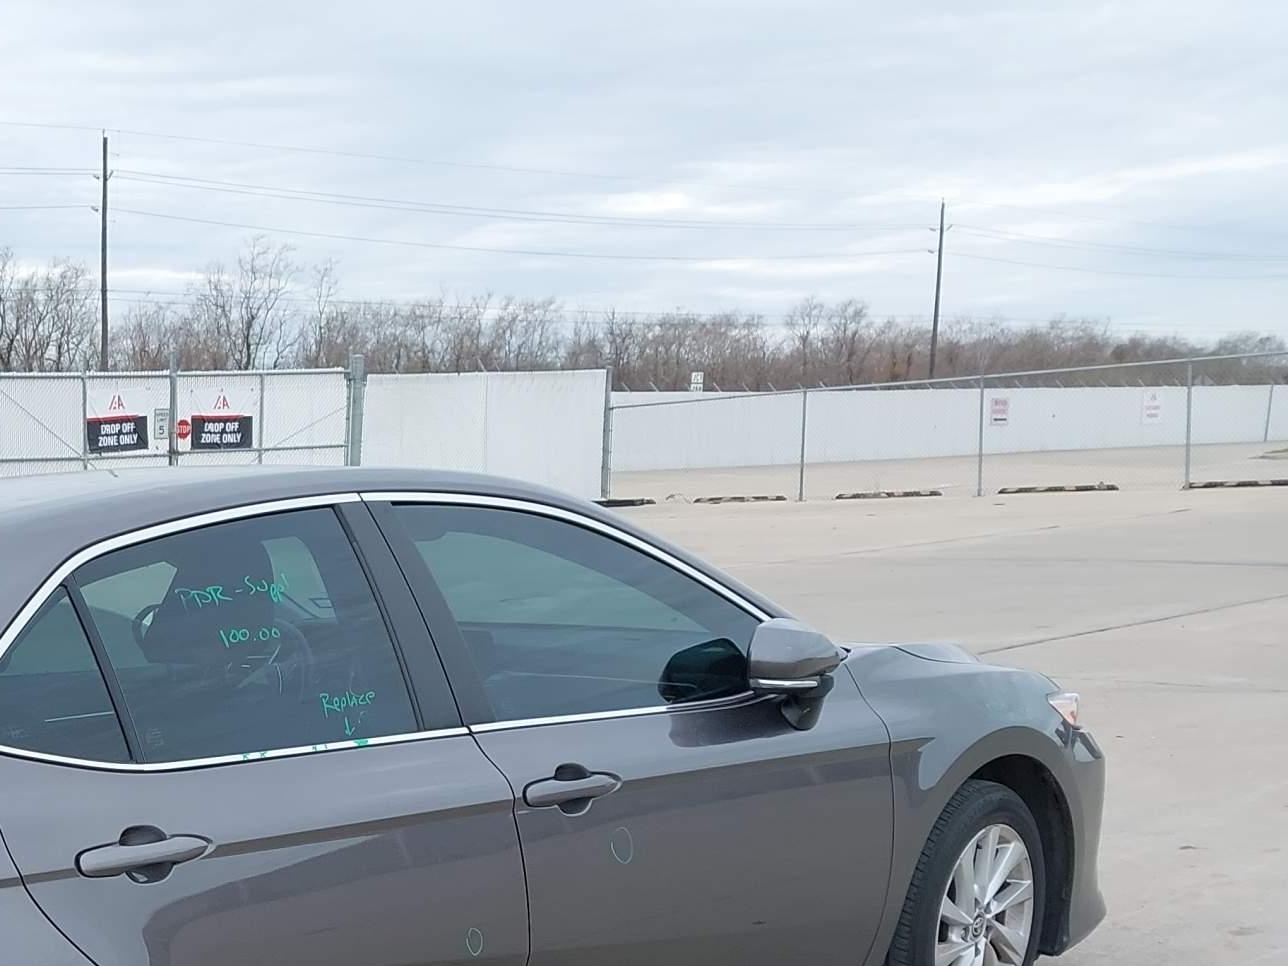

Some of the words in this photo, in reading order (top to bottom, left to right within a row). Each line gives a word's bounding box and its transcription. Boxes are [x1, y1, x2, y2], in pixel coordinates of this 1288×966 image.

[100, 423, 121, 435] DROP
[121, 422, 136, 433] OFF
[158, 425, 165, 435] 5
[177, 425, 190, 433] STOP
[204, 422, 225, 433] DROP
[225, 422, 240, 432] OFF
[98, 435, 119, 447] ZONE
[119, 433, 138, 445] ONLY
[200, 433, 221, 444] ZONE
[222, 433, 242, 443] ONLY
[219, 627, 281, 648] 100.00
[319, 691, 376, 719] Replace
